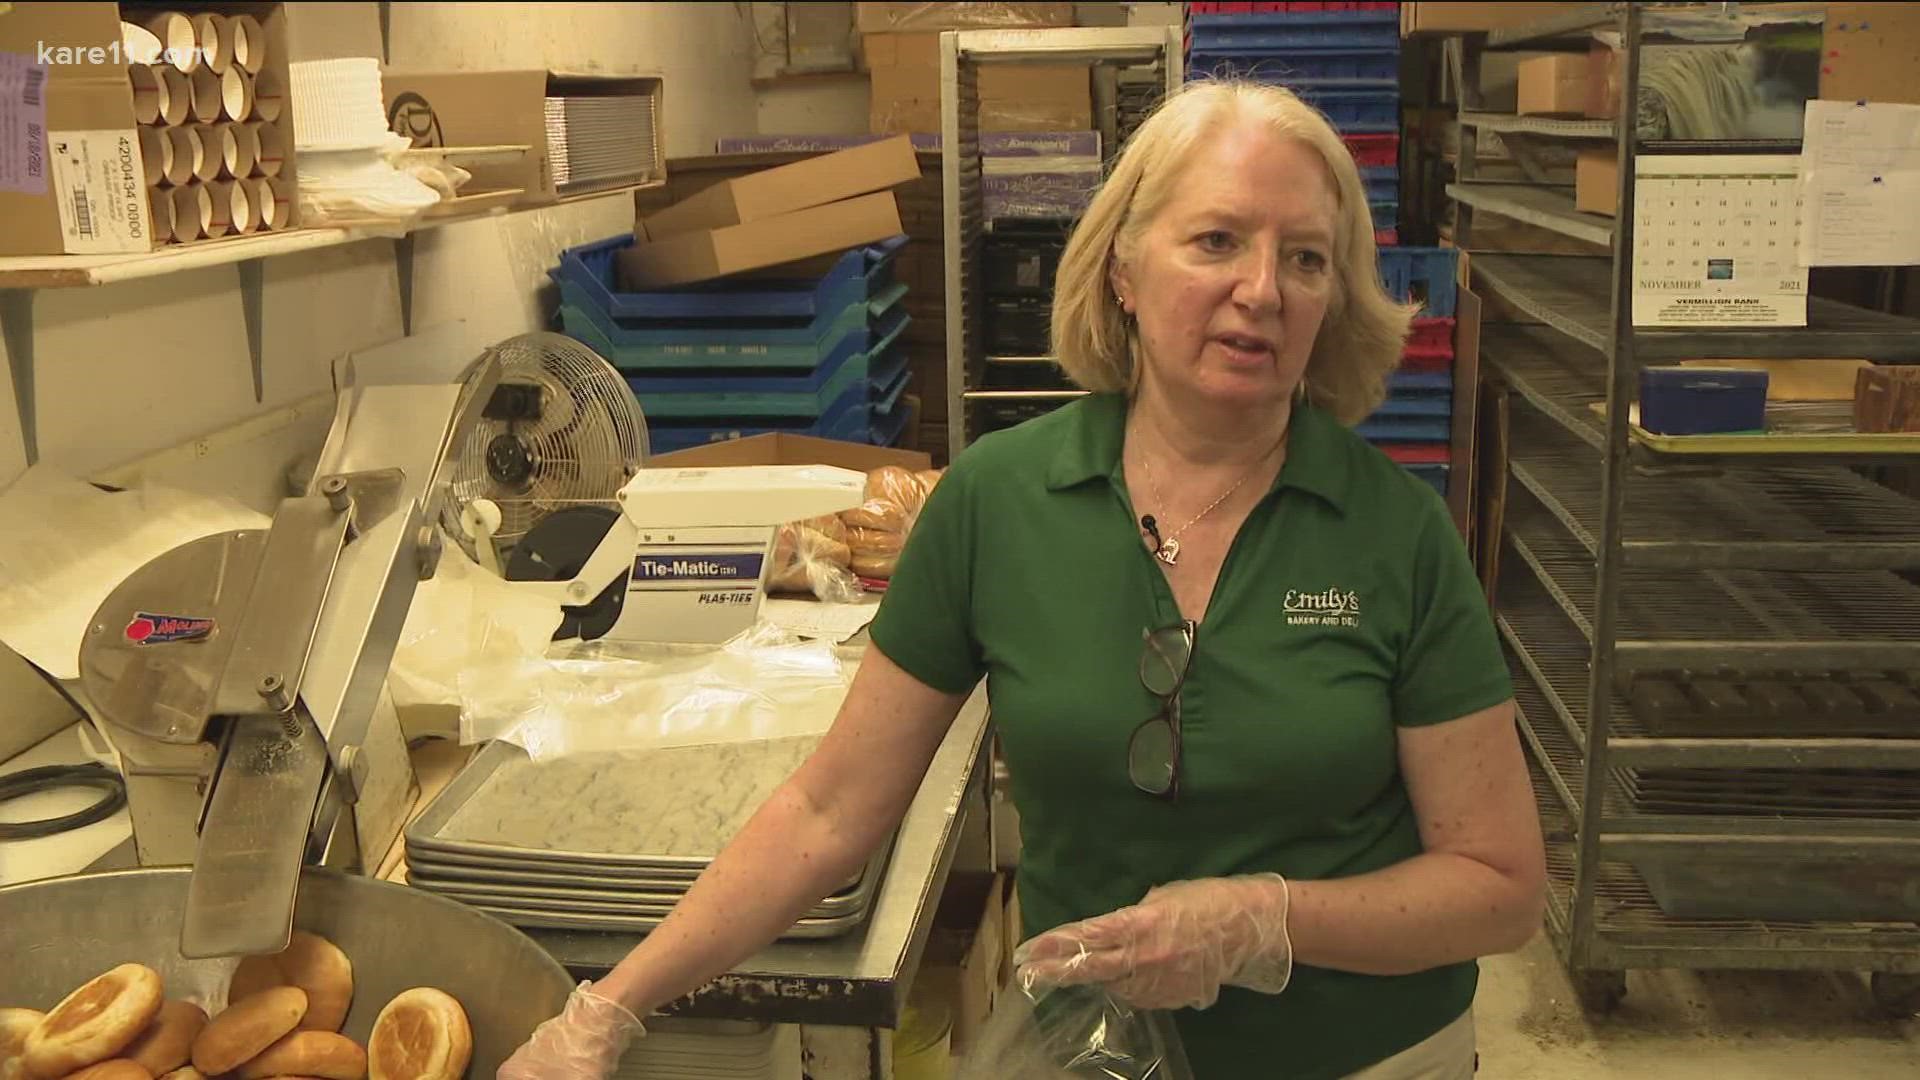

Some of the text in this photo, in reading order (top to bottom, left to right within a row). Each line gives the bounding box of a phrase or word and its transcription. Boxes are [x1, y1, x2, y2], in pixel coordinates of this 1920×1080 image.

[1640, 280, 1801, 290] NOVEMBER 2021
[641, 561, 720, 577] Tie-Matic
[1287, 616, 1319, 625] BAKERY
[1321, 616, 1339, 625] AND
